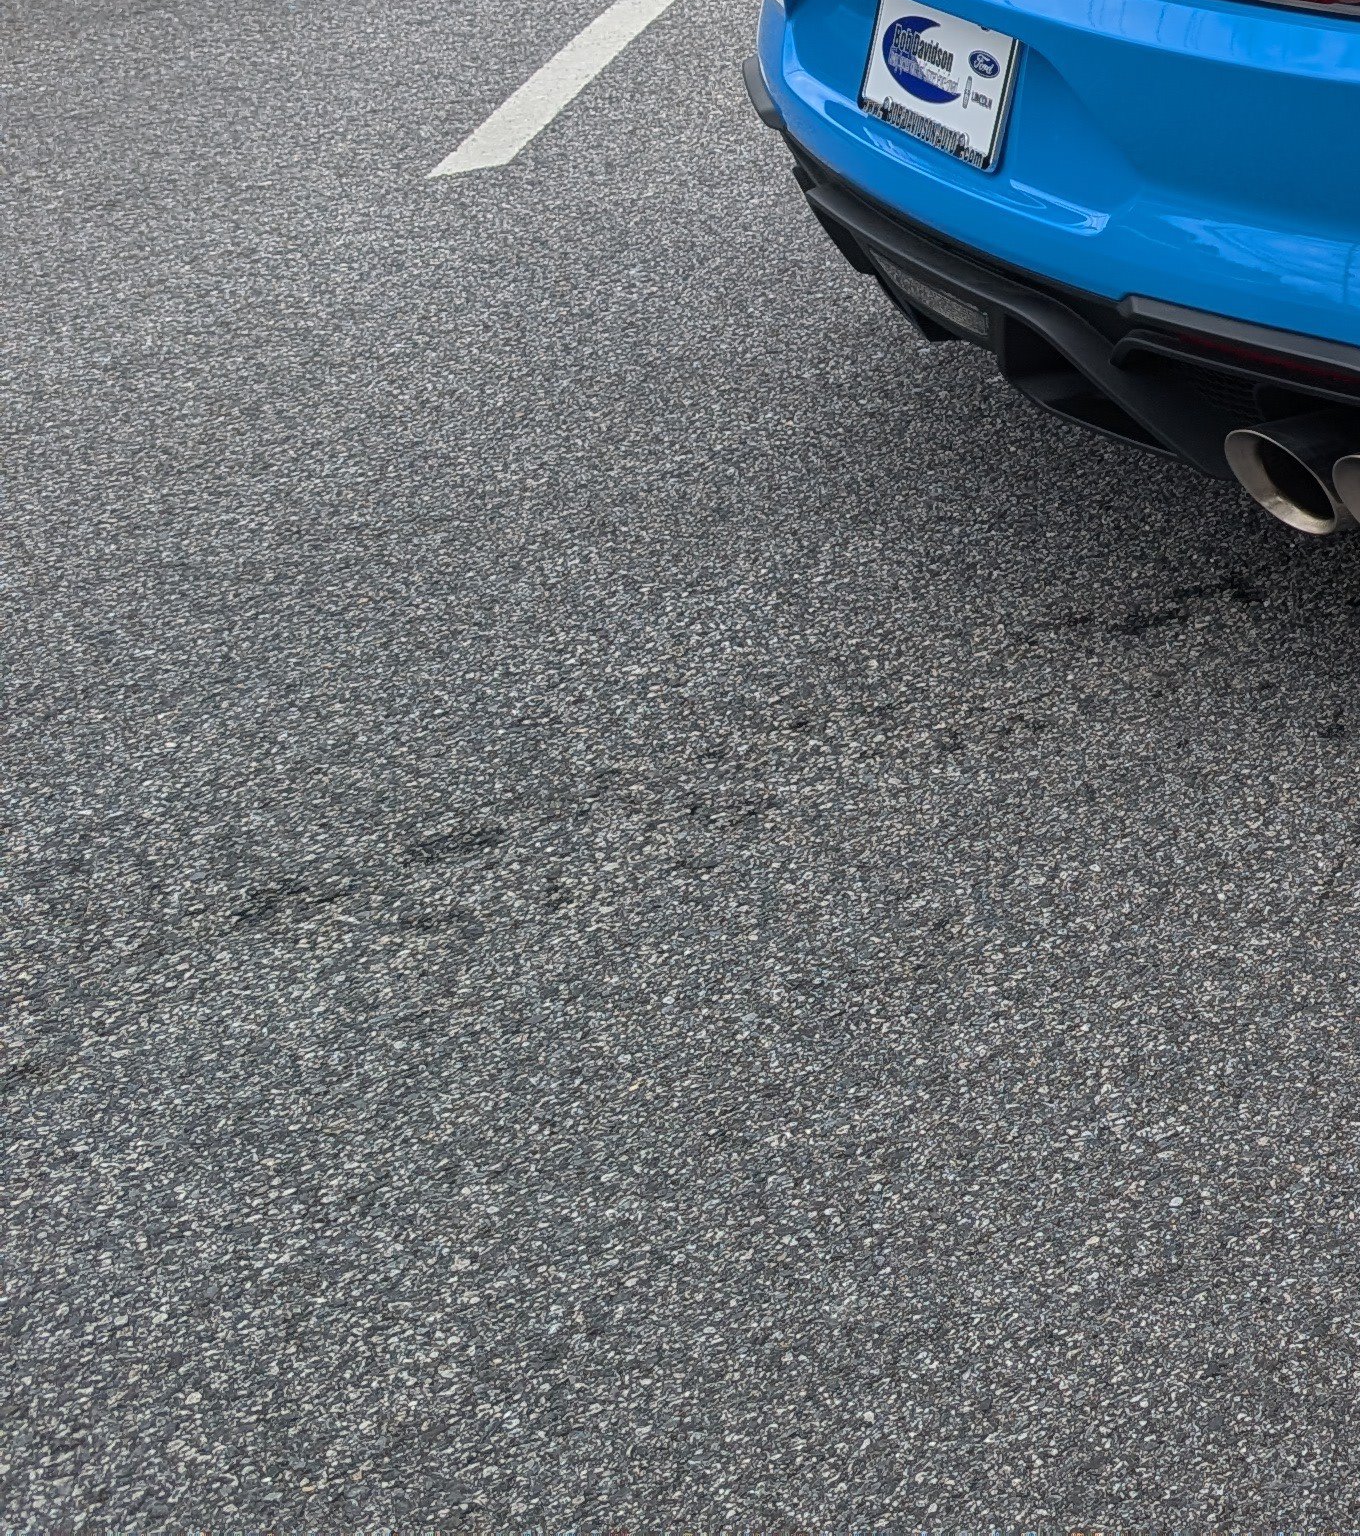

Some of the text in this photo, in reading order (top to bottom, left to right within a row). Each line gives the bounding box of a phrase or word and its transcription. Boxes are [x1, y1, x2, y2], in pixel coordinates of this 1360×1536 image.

[893, 23, 914, 53] Bob
[911, 31, 955, 73] Davidson
[973, 54, 995, 75] Ford
